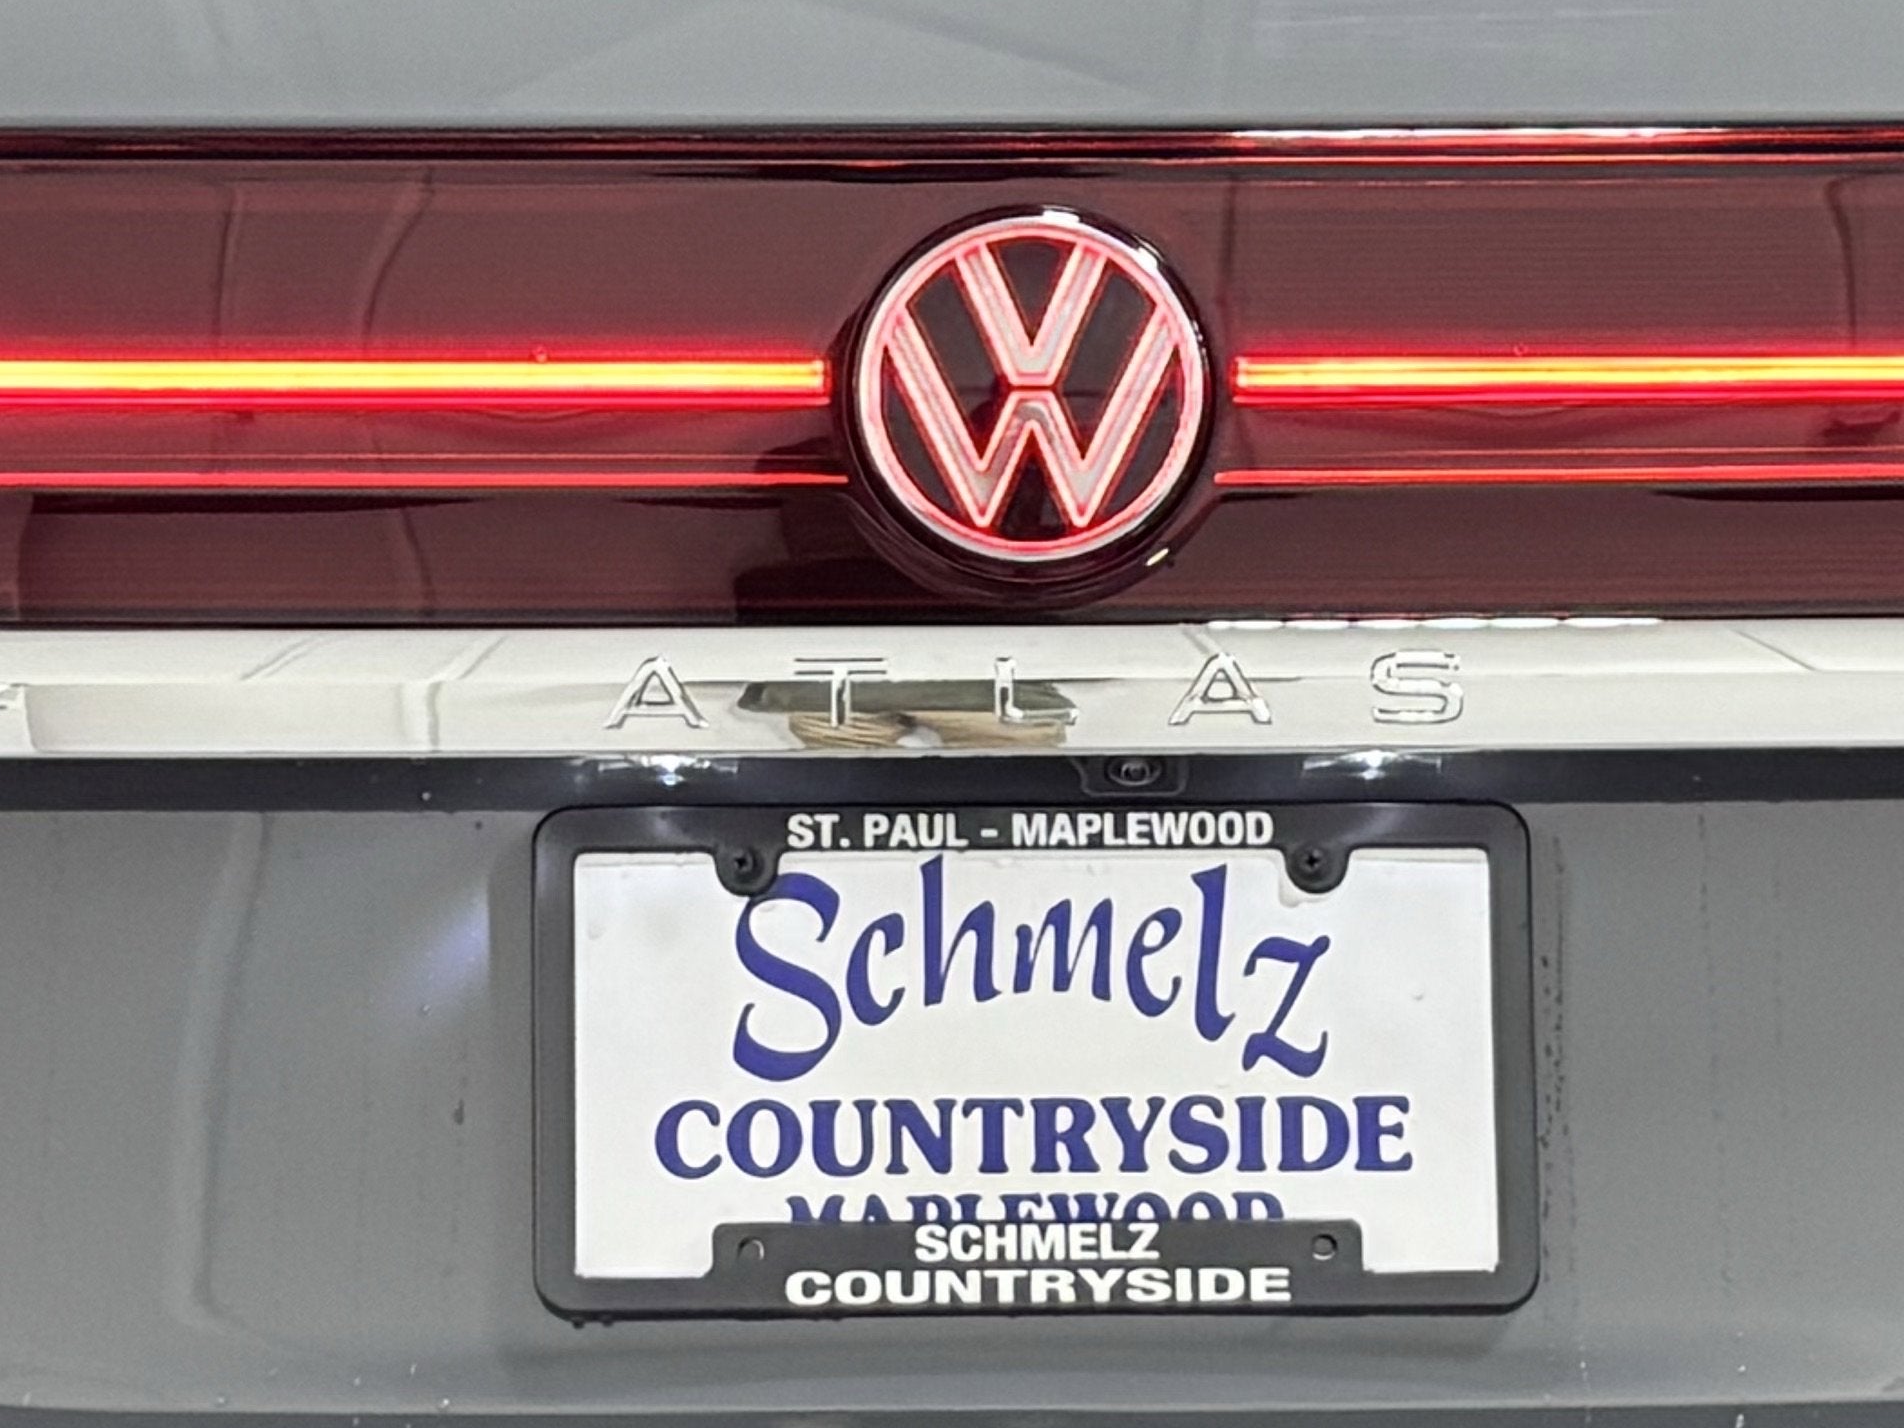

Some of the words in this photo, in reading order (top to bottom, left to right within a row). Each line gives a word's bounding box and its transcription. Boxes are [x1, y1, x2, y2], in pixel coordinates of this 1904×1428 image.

[602, 650, 1466, 730] ATLAS
[786, 812, 852, 849] ST.
[862, 812, 969, 848] PAUL
[1010, 810, 1275, 848] MAPLEWOOD
[731, 853, 1332, 1083] Schmelz
[653, 1094, 1413, 1180] COUNTRYSIDE
[914, 1223, 1160, 1263] SCHMELZ
[784, 1266, 1293, 1307] COUNTRYSIDE
